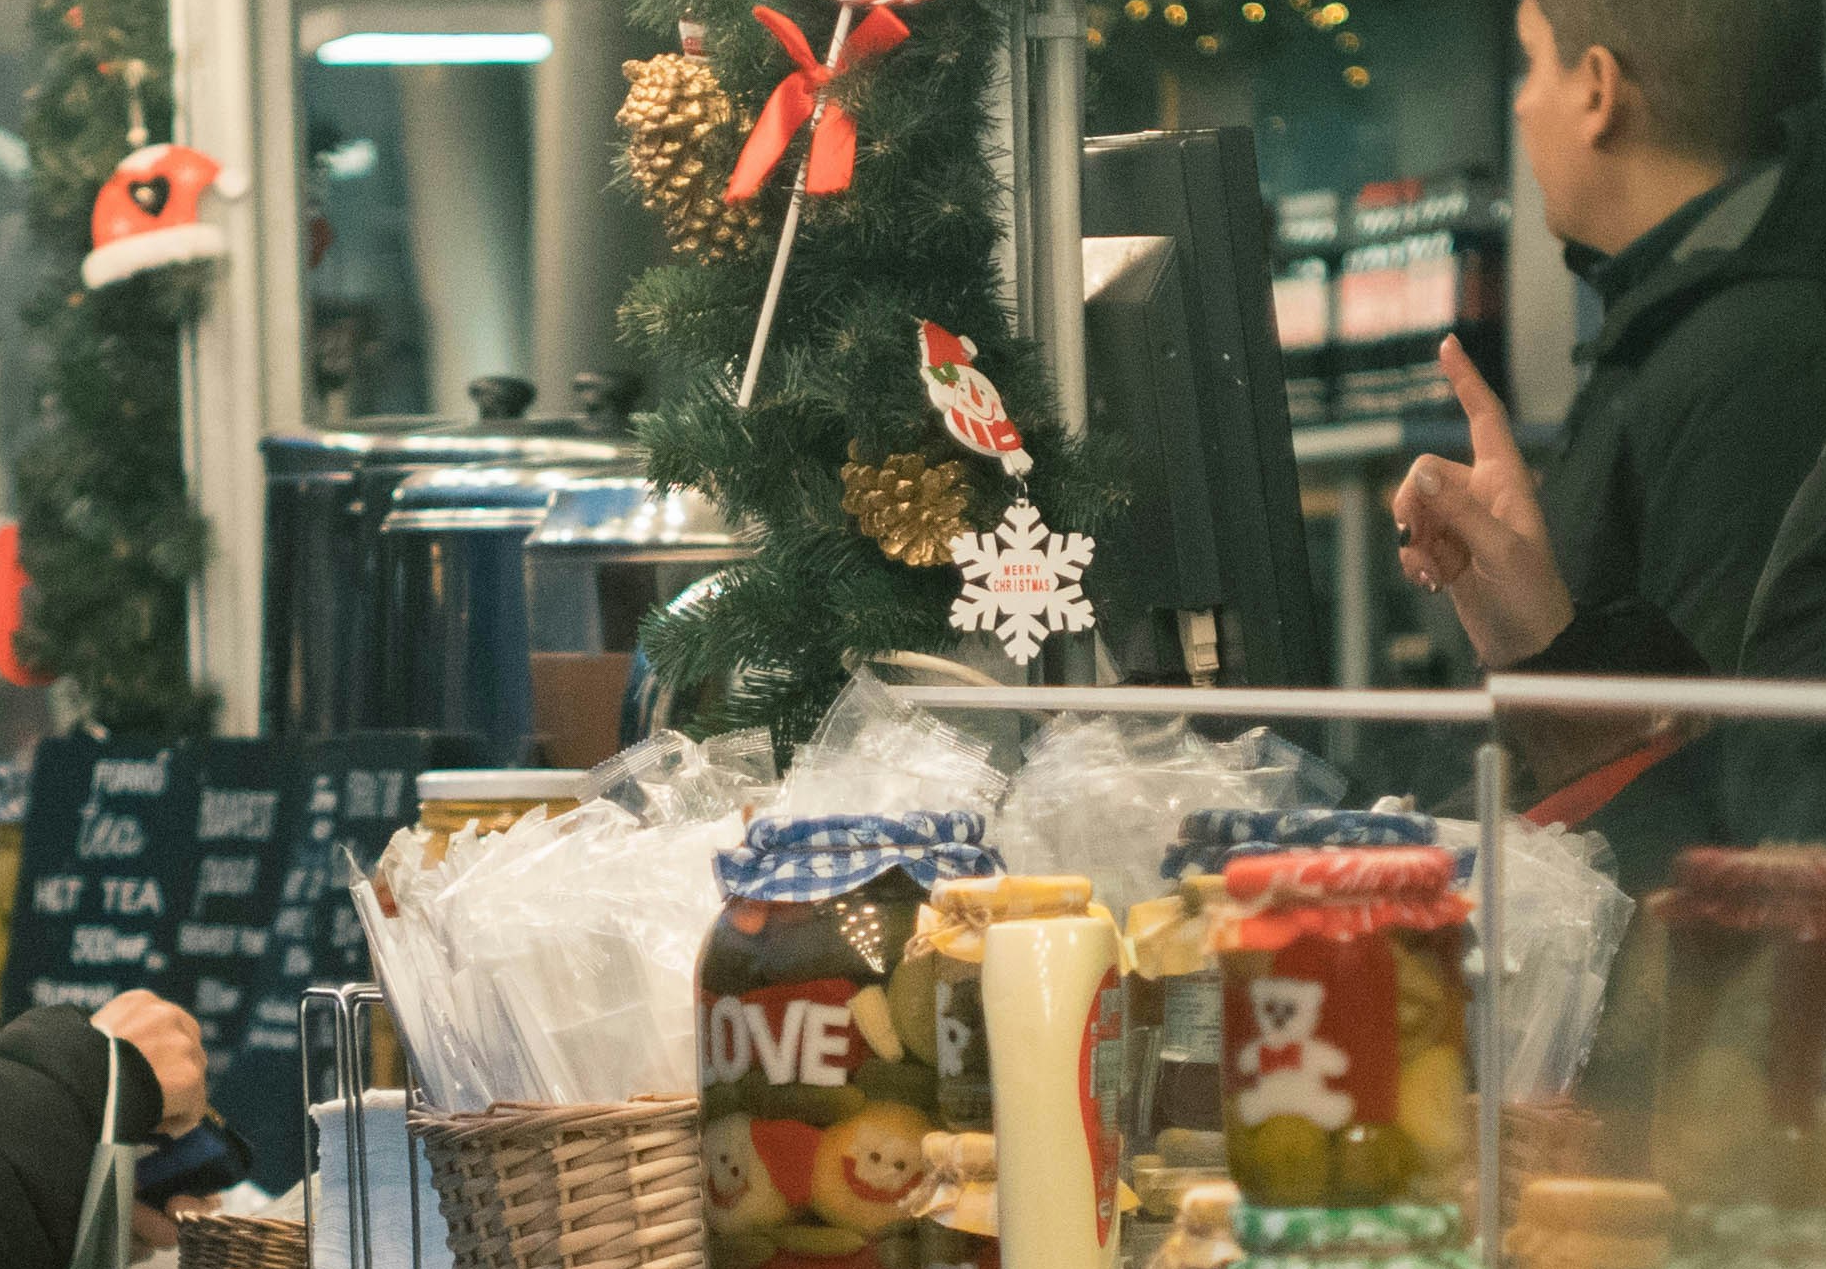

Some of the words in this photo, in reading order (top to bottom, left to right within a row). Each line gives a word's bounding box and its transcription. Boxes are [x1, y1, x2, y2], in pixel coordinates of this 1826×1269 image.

[1004, 564, 1040, 576] MERRY
[994, 579, 1050, 592] CHRISTMAS
[101, 877, 164, 915] TEA
